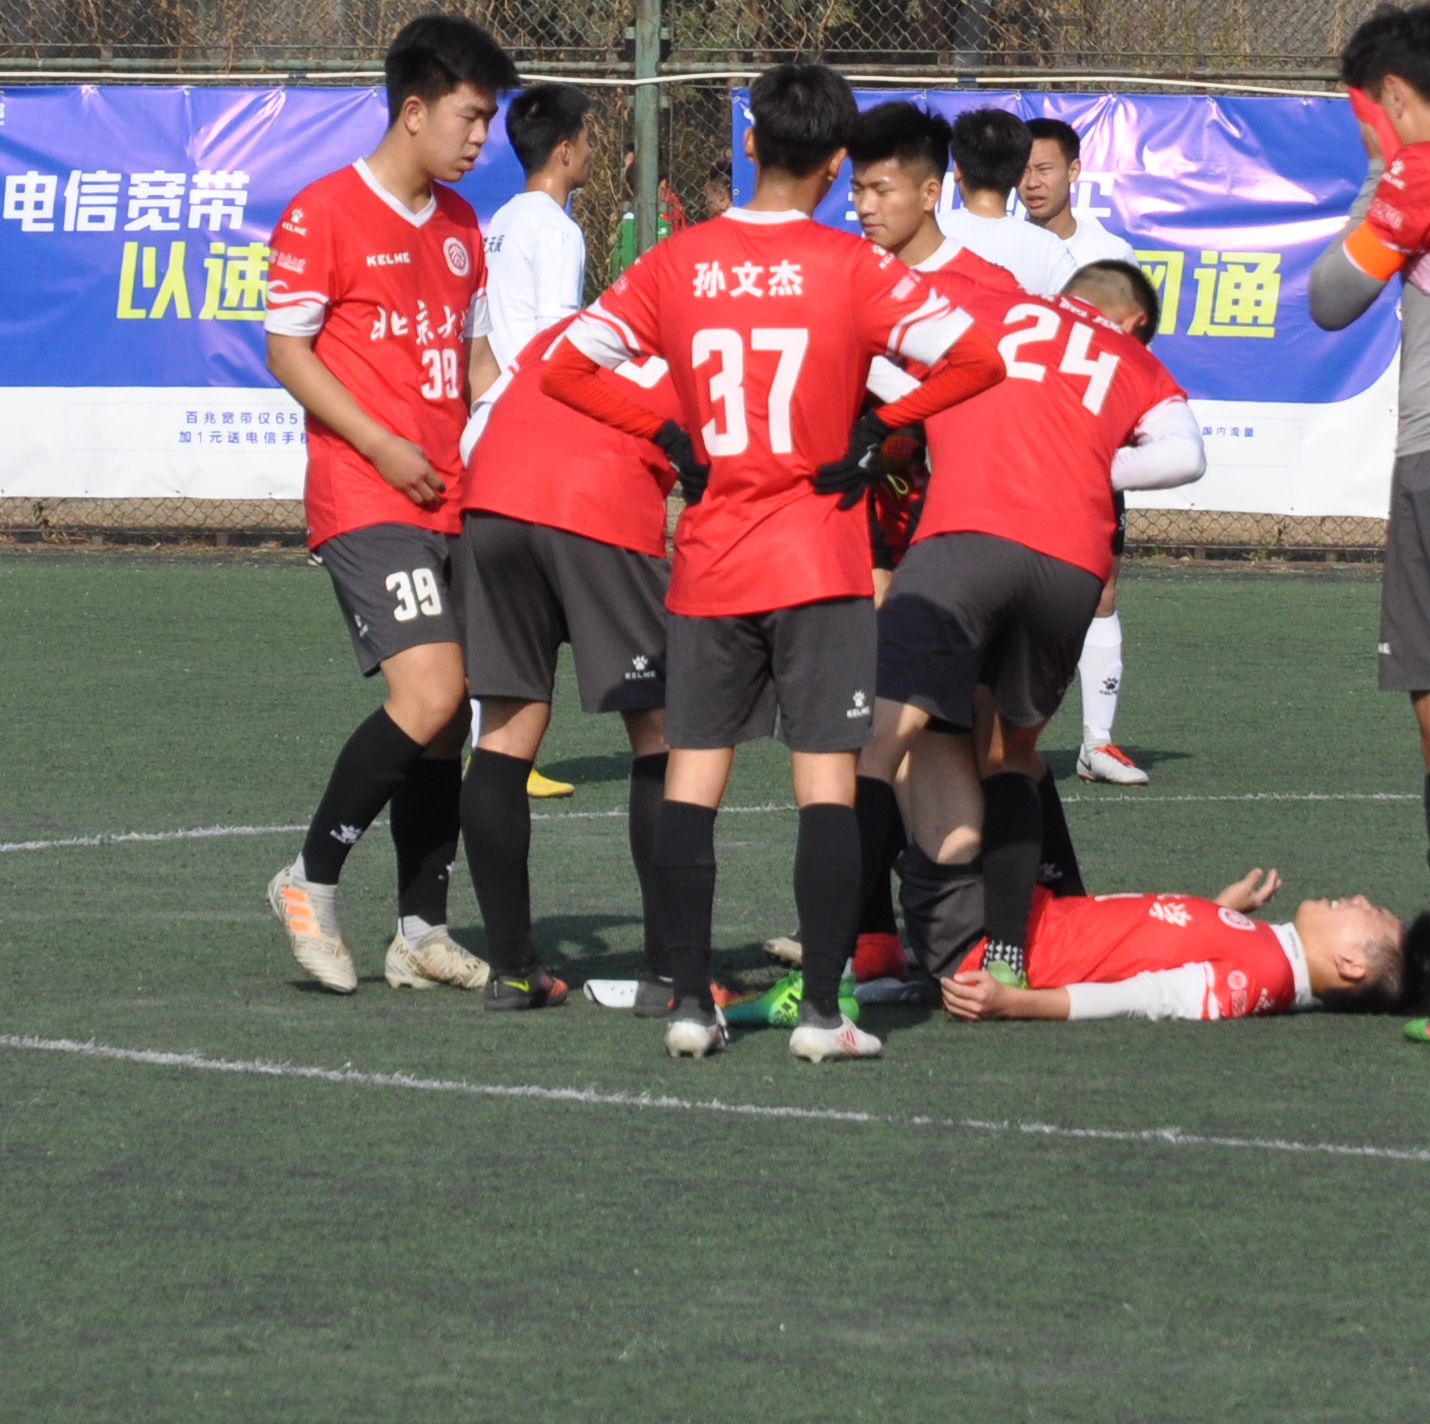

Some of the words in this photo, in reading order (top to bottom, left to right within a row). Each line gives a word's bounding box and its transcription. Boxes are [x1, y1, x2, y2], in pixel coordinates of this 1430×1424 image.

[2, 169, 251, 233] 电信宽带
[281, 221, 308, 237] KELME
[365, 251, 412, 268] KELME
[693, 260, 803, 299] 孙文杰
[420, 348, 459, 400] 39
[996, 303, 1120, 416] 24
[691, 327, 809, 457] 37
[185, 411, 307, 426] 百兆宽带仅65
[384, 567, 443, 623] 39
[624, 669, 656, 680] KELME
[846, 705, 870, 720] KELME
